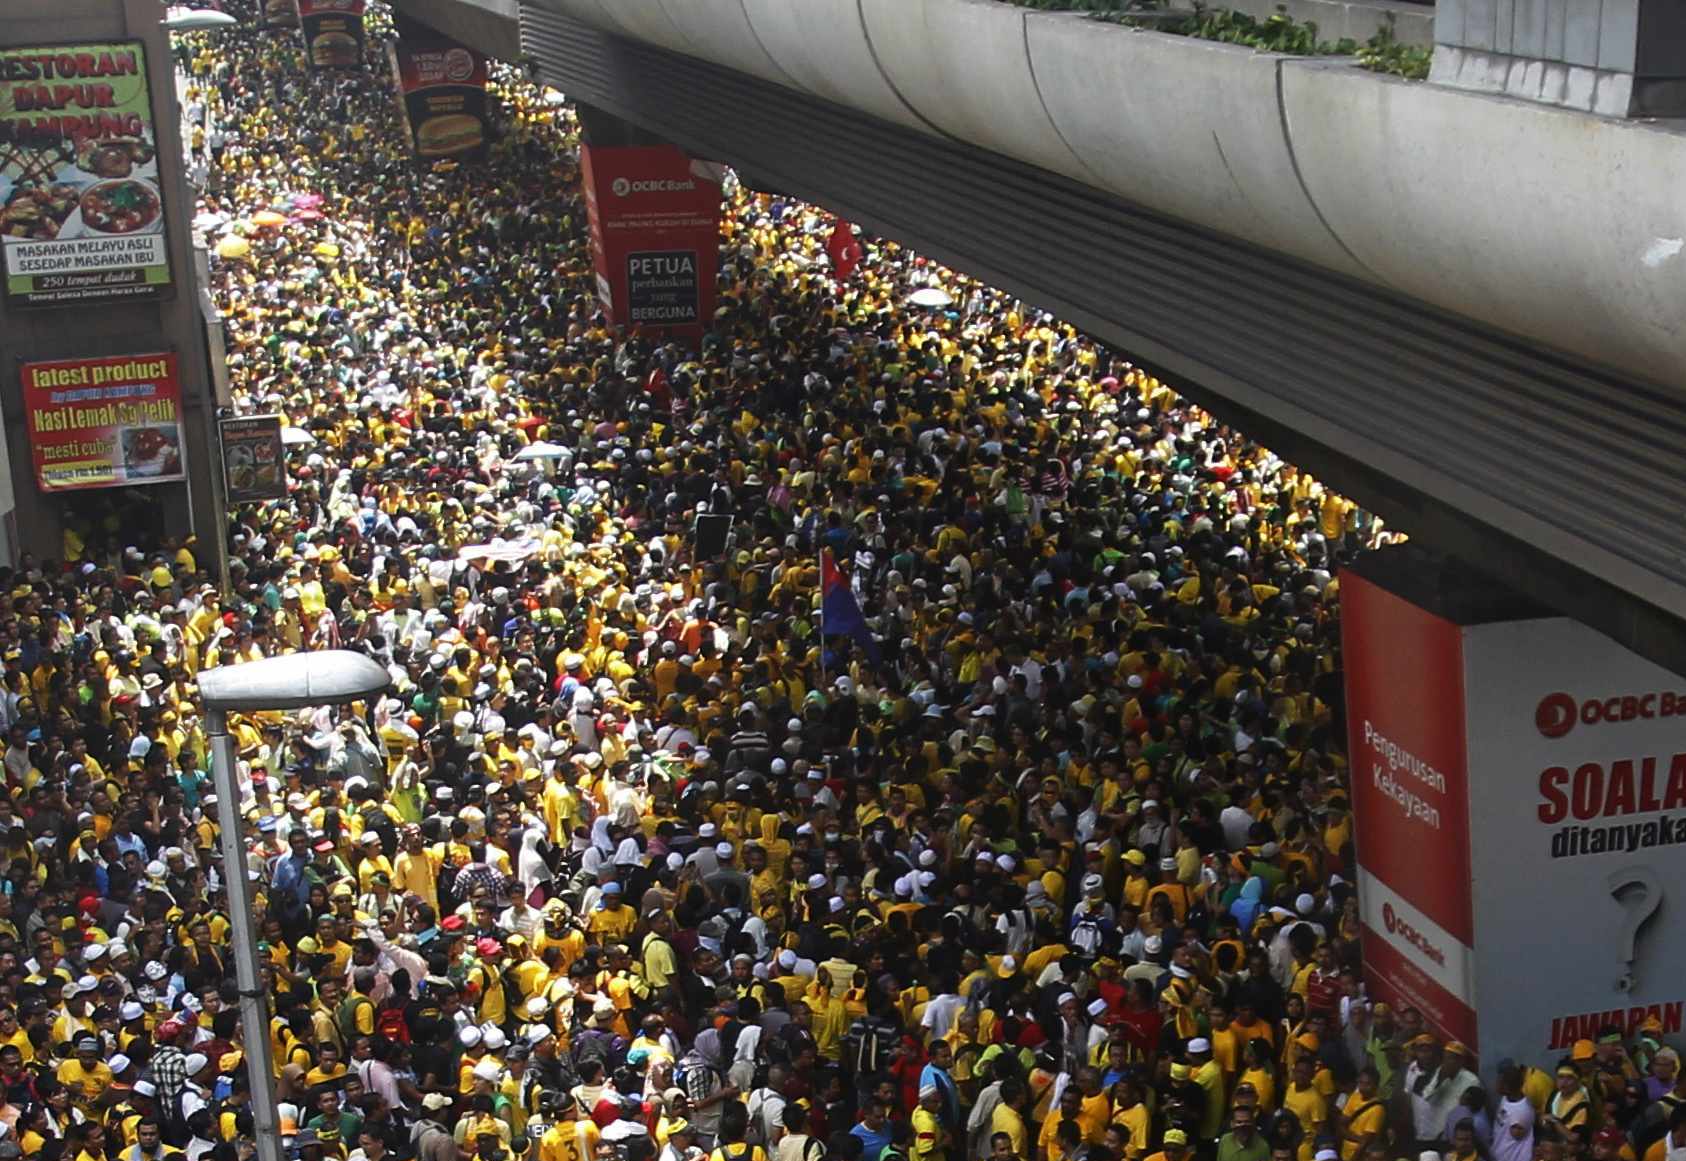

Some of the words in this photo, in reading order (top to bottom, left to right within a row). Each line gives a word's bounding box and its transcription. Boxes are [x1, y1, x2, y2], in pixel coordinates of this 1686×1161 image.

[0, 52, 137, 80] ESTORAN
[15, 82, 114, 111] DAPUR
[632, 180, 667, 192] OCBC
[668, 178, 696, 191] Bank
[17, 243, 75, 258] MASAKAN
[79, 240, 125, 254] MELAYU
[127, 237, 153, 250] ASLI
[20, 257, 73, 272] SESEDAP
[75, 254, 133, 268] MASAKAN
[135, 251, 154, 263] IBU
[630, 257, 694, 275] PETUA
[43, 277, 65, 288] 250
[632, 275, 694, 292] perbankan
[632, 306, 697, 320] BERGUNA
[92, 360, 169, 385] product
[34, 405, 68, 433] Nasi
[69, 403, 118, 429] Lemak
[1580, 693, 1658, 725] OCBC
[1365, 720, 1445, 794] Pengurusan
[1373, 763, 1440, 829] Kekayaan
[1398, 917, 1424, 950] OCBC
